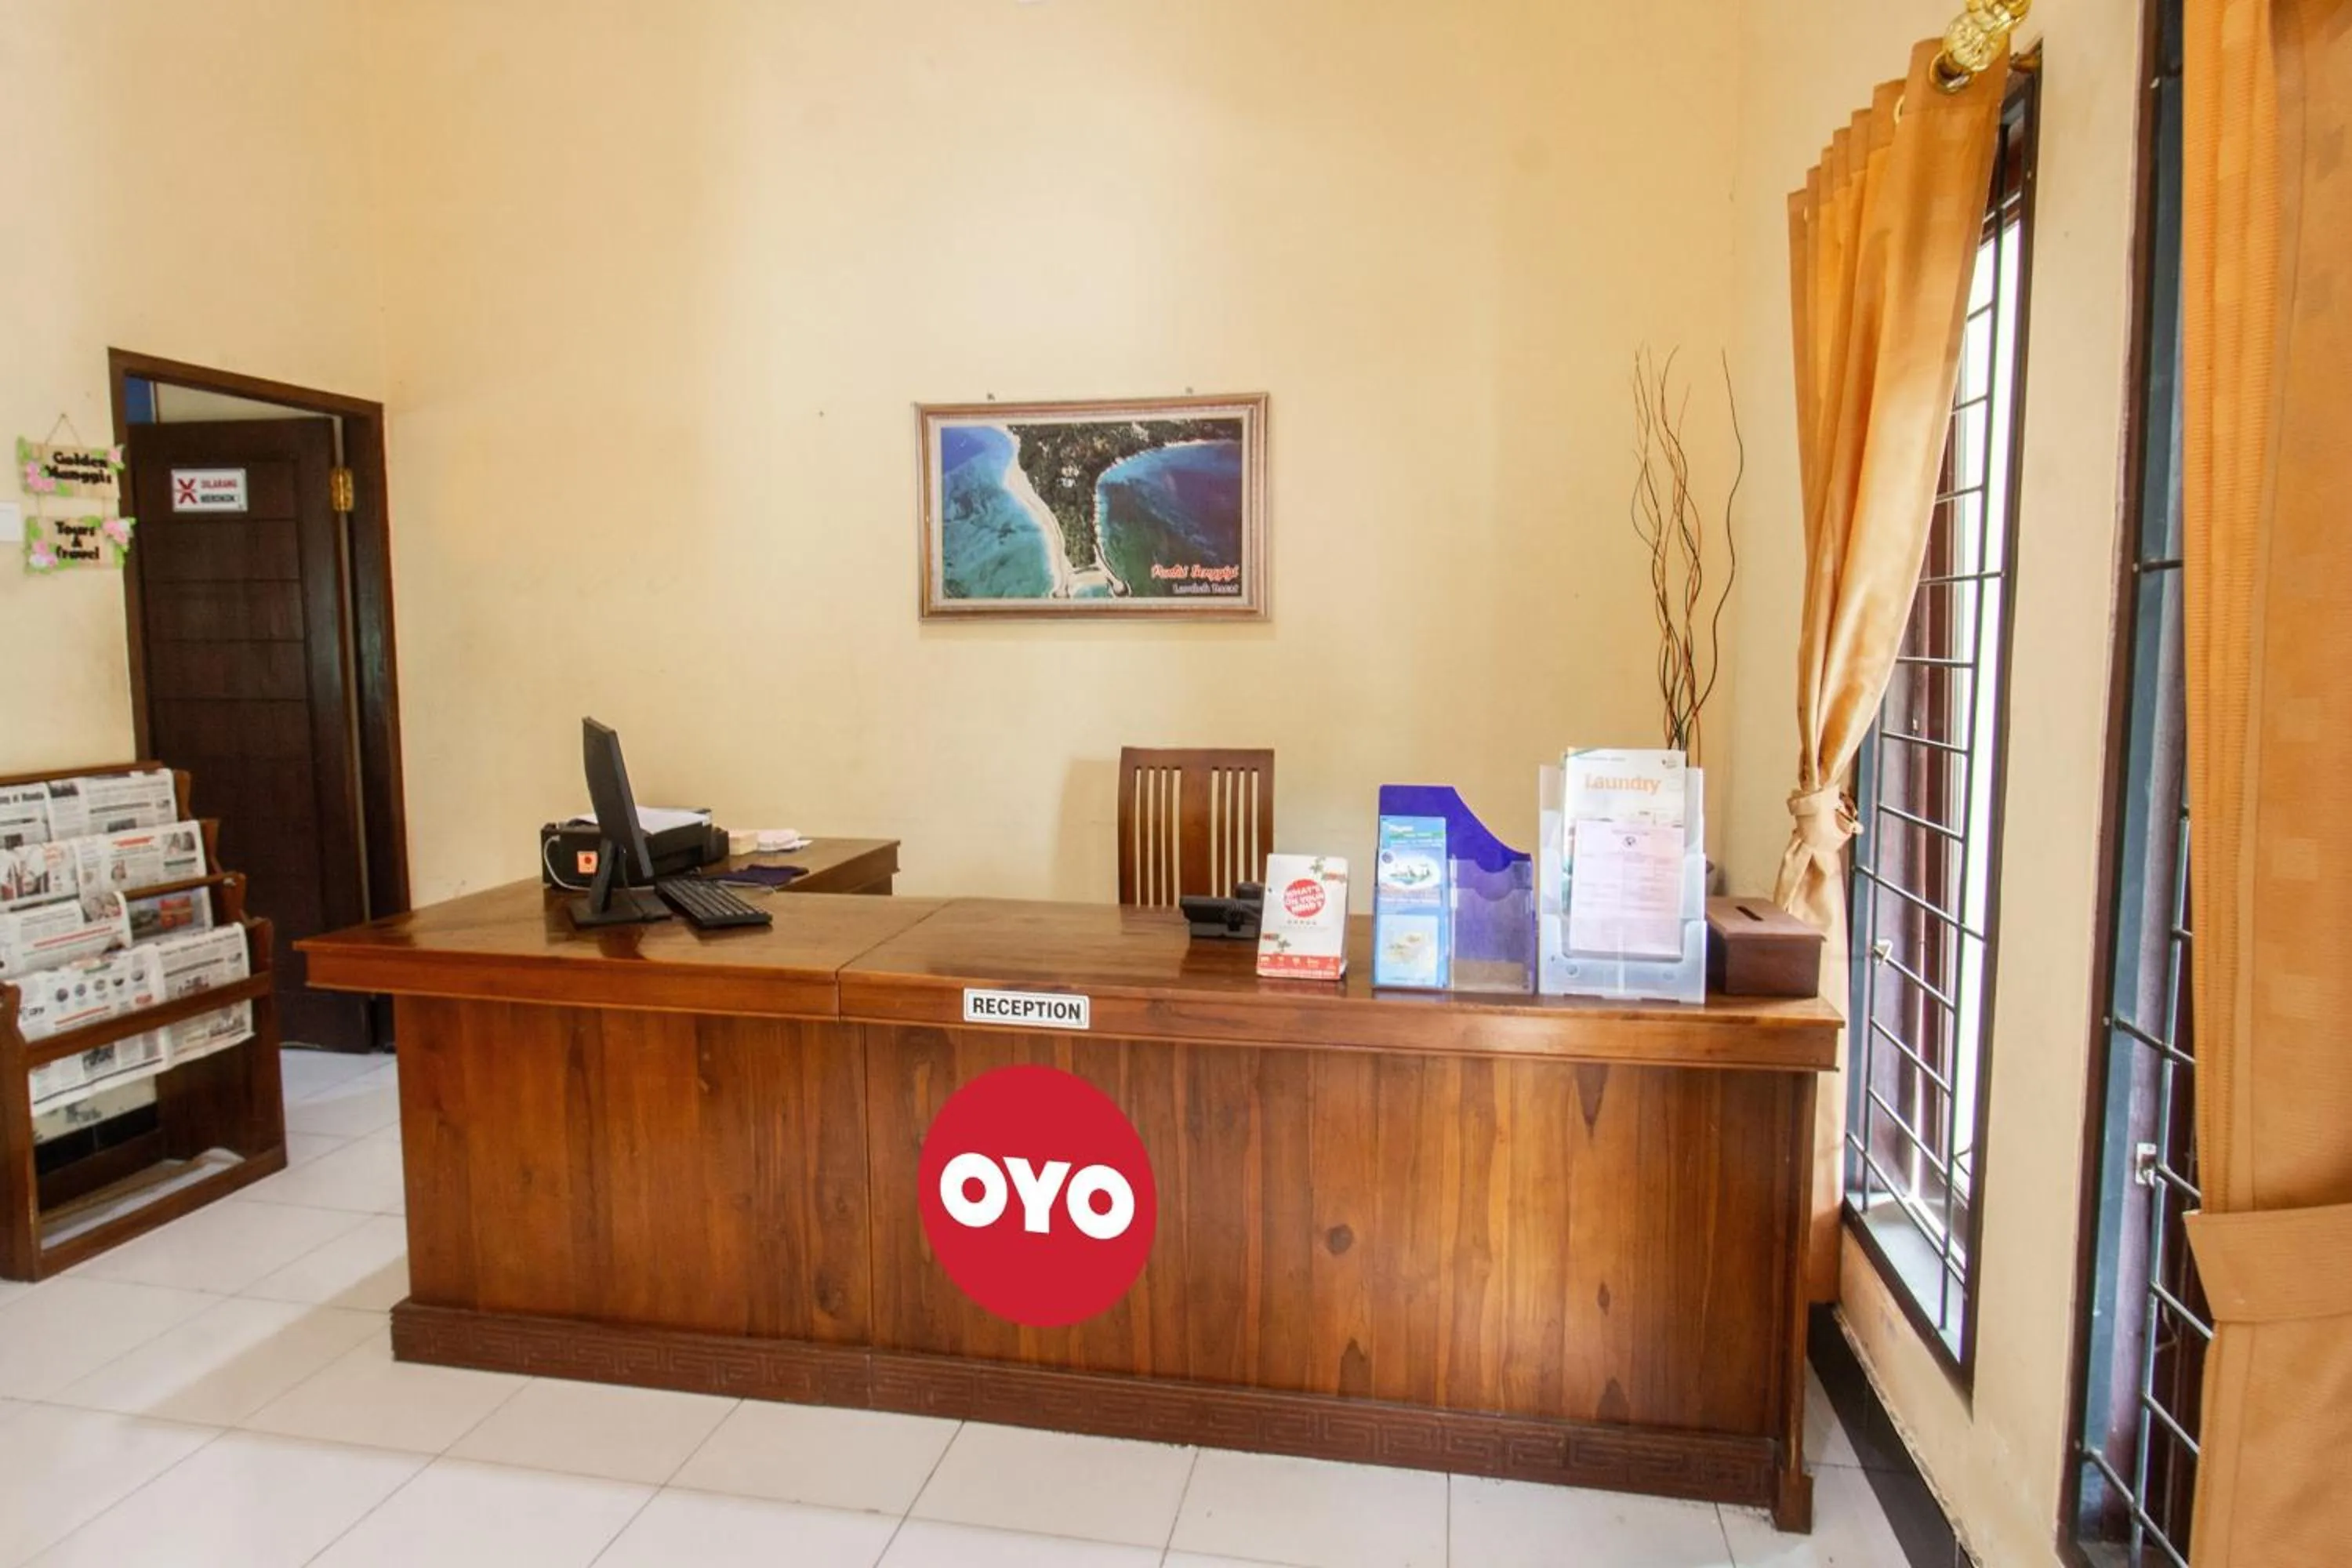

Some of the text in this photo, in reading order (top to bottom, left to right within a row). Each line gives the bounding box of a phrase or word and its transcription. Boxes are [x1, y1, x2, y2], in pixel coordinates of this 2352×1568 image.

[55, 521, 96, 536] Tours
[1584, 774, 1661, 796] Laundry
[972, 996, 1081, 1020] RECEPTION
[939, 1152, 1135, 1240] OYO
